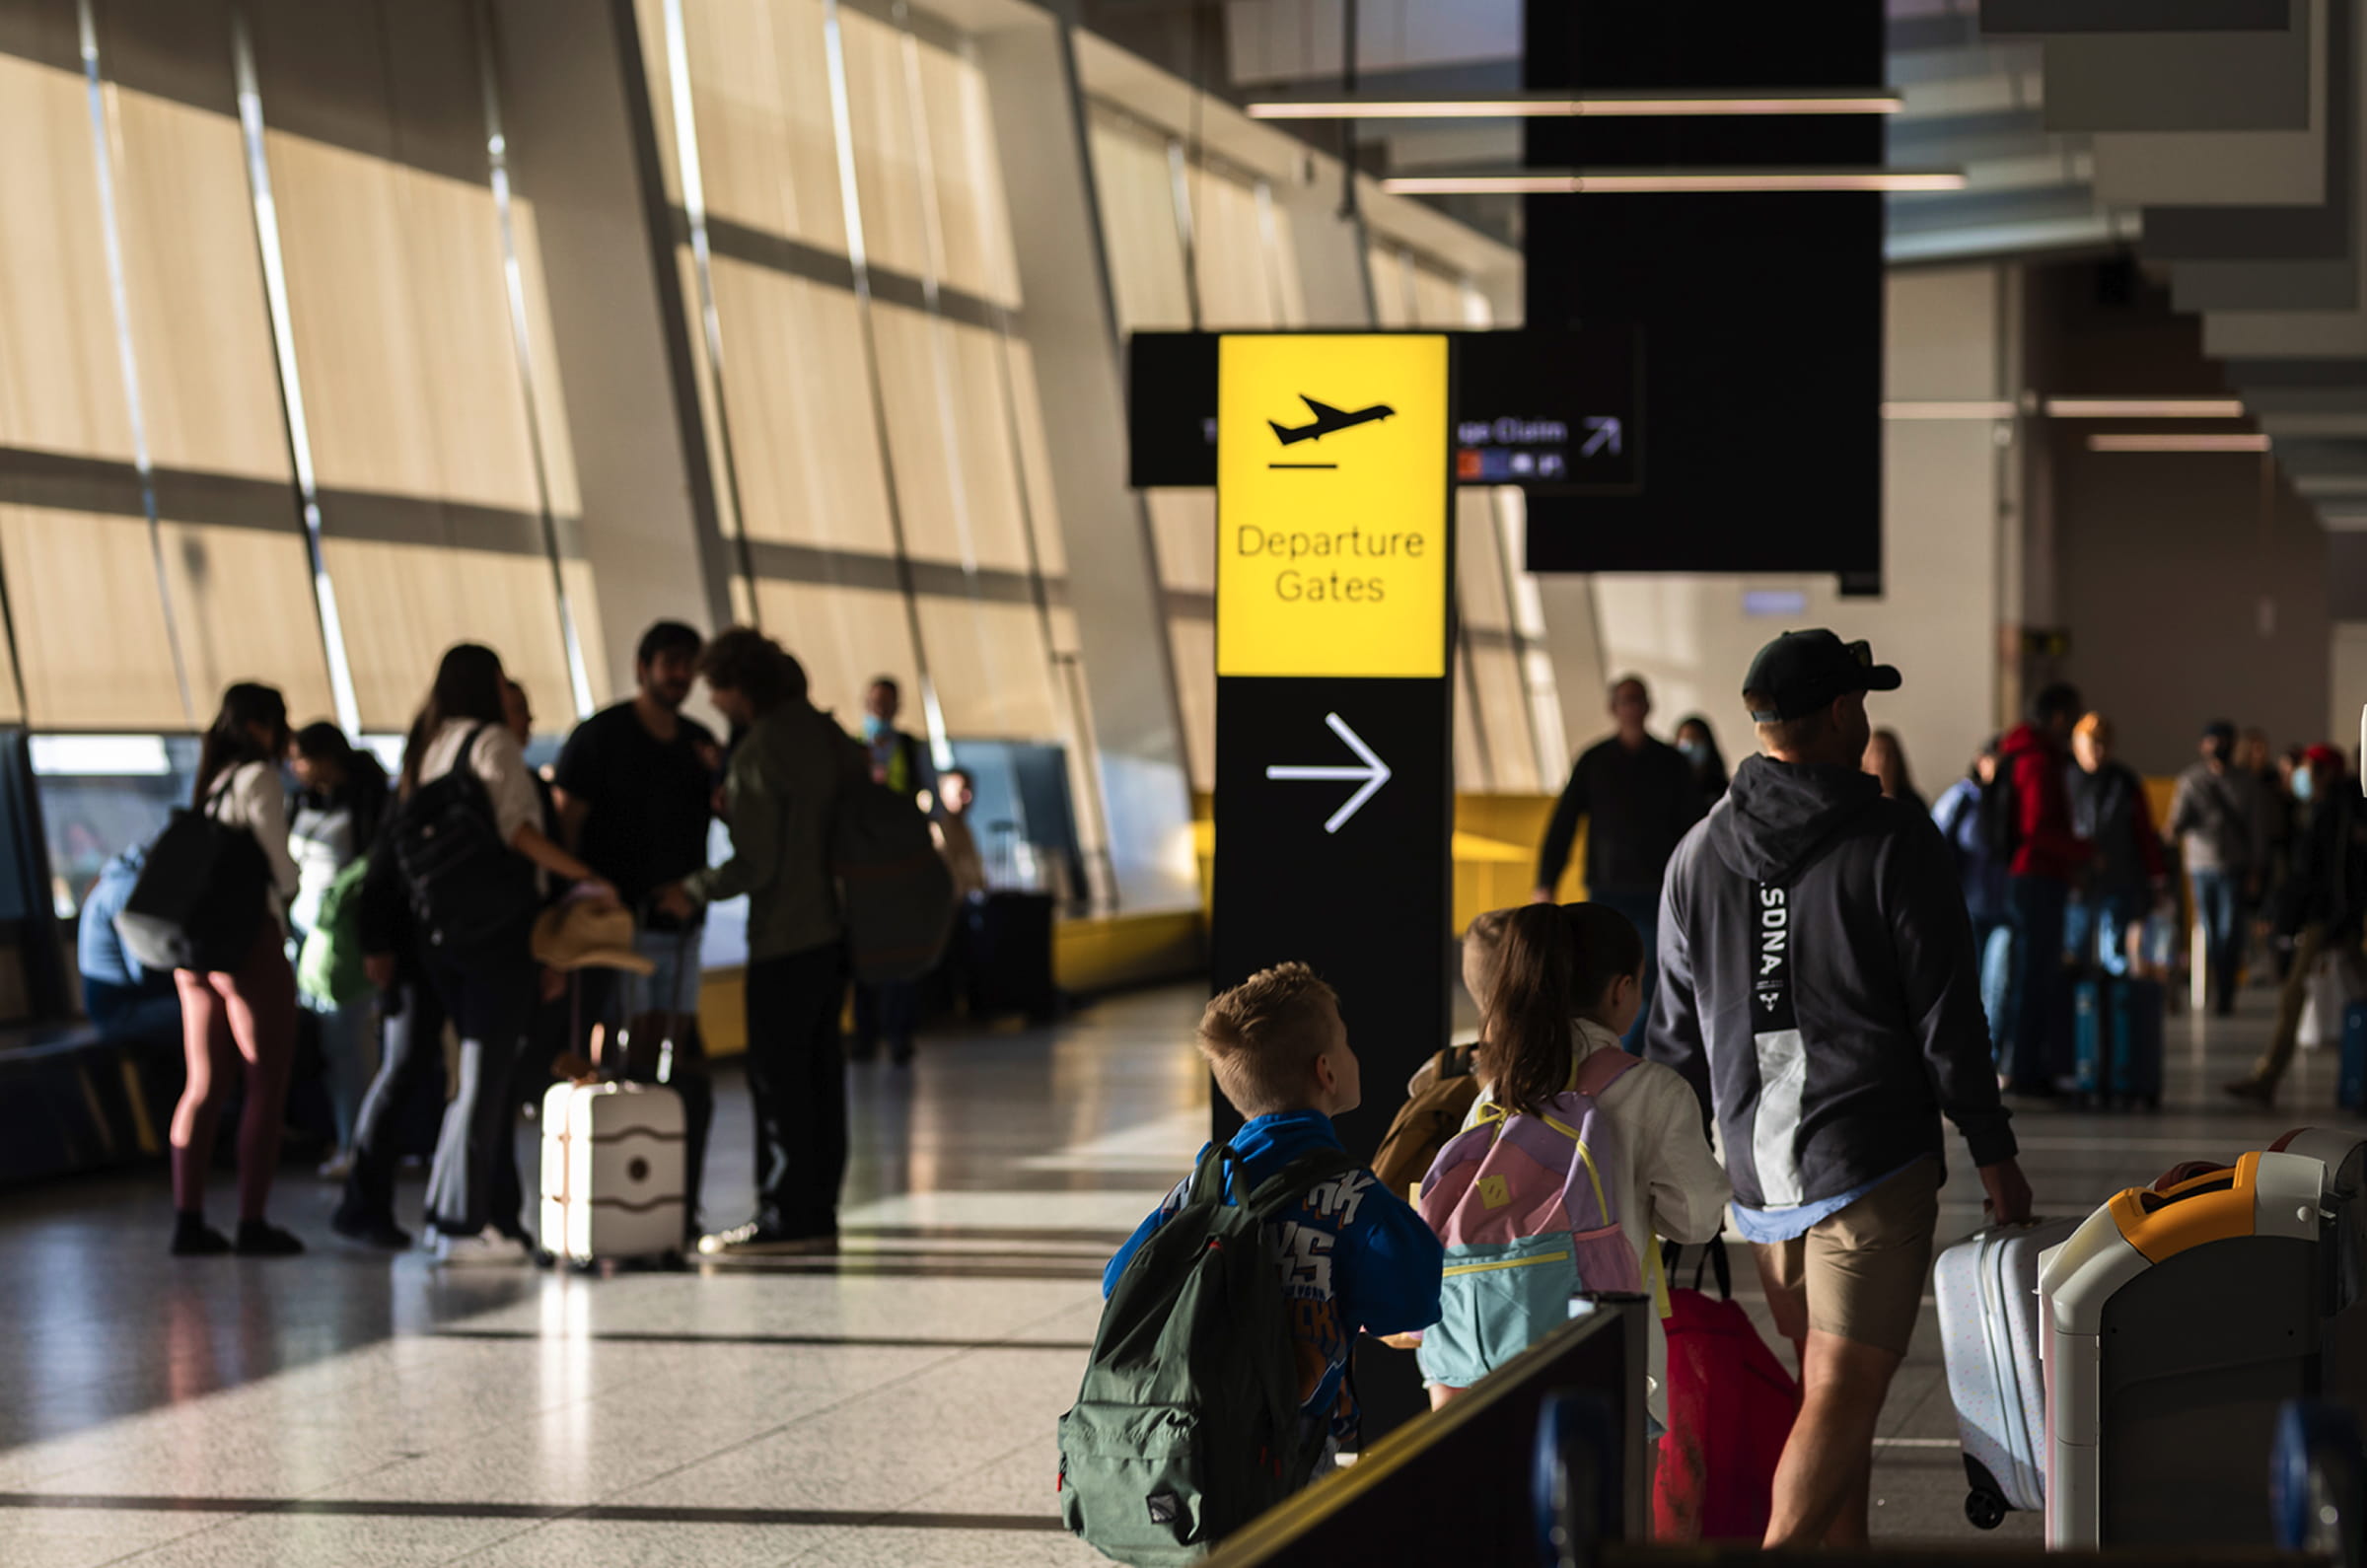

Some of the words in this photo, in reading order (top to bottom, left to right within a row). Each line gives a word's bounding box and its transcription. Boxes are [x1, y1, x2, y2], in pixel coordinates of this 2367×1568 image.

[1494, 415, 1567, 444] Claim
[1237, 524, 1425, 561] Departure
[1275, 569, 1385, 603] Gates
[1759, 882, 1786, 974] SDNA
